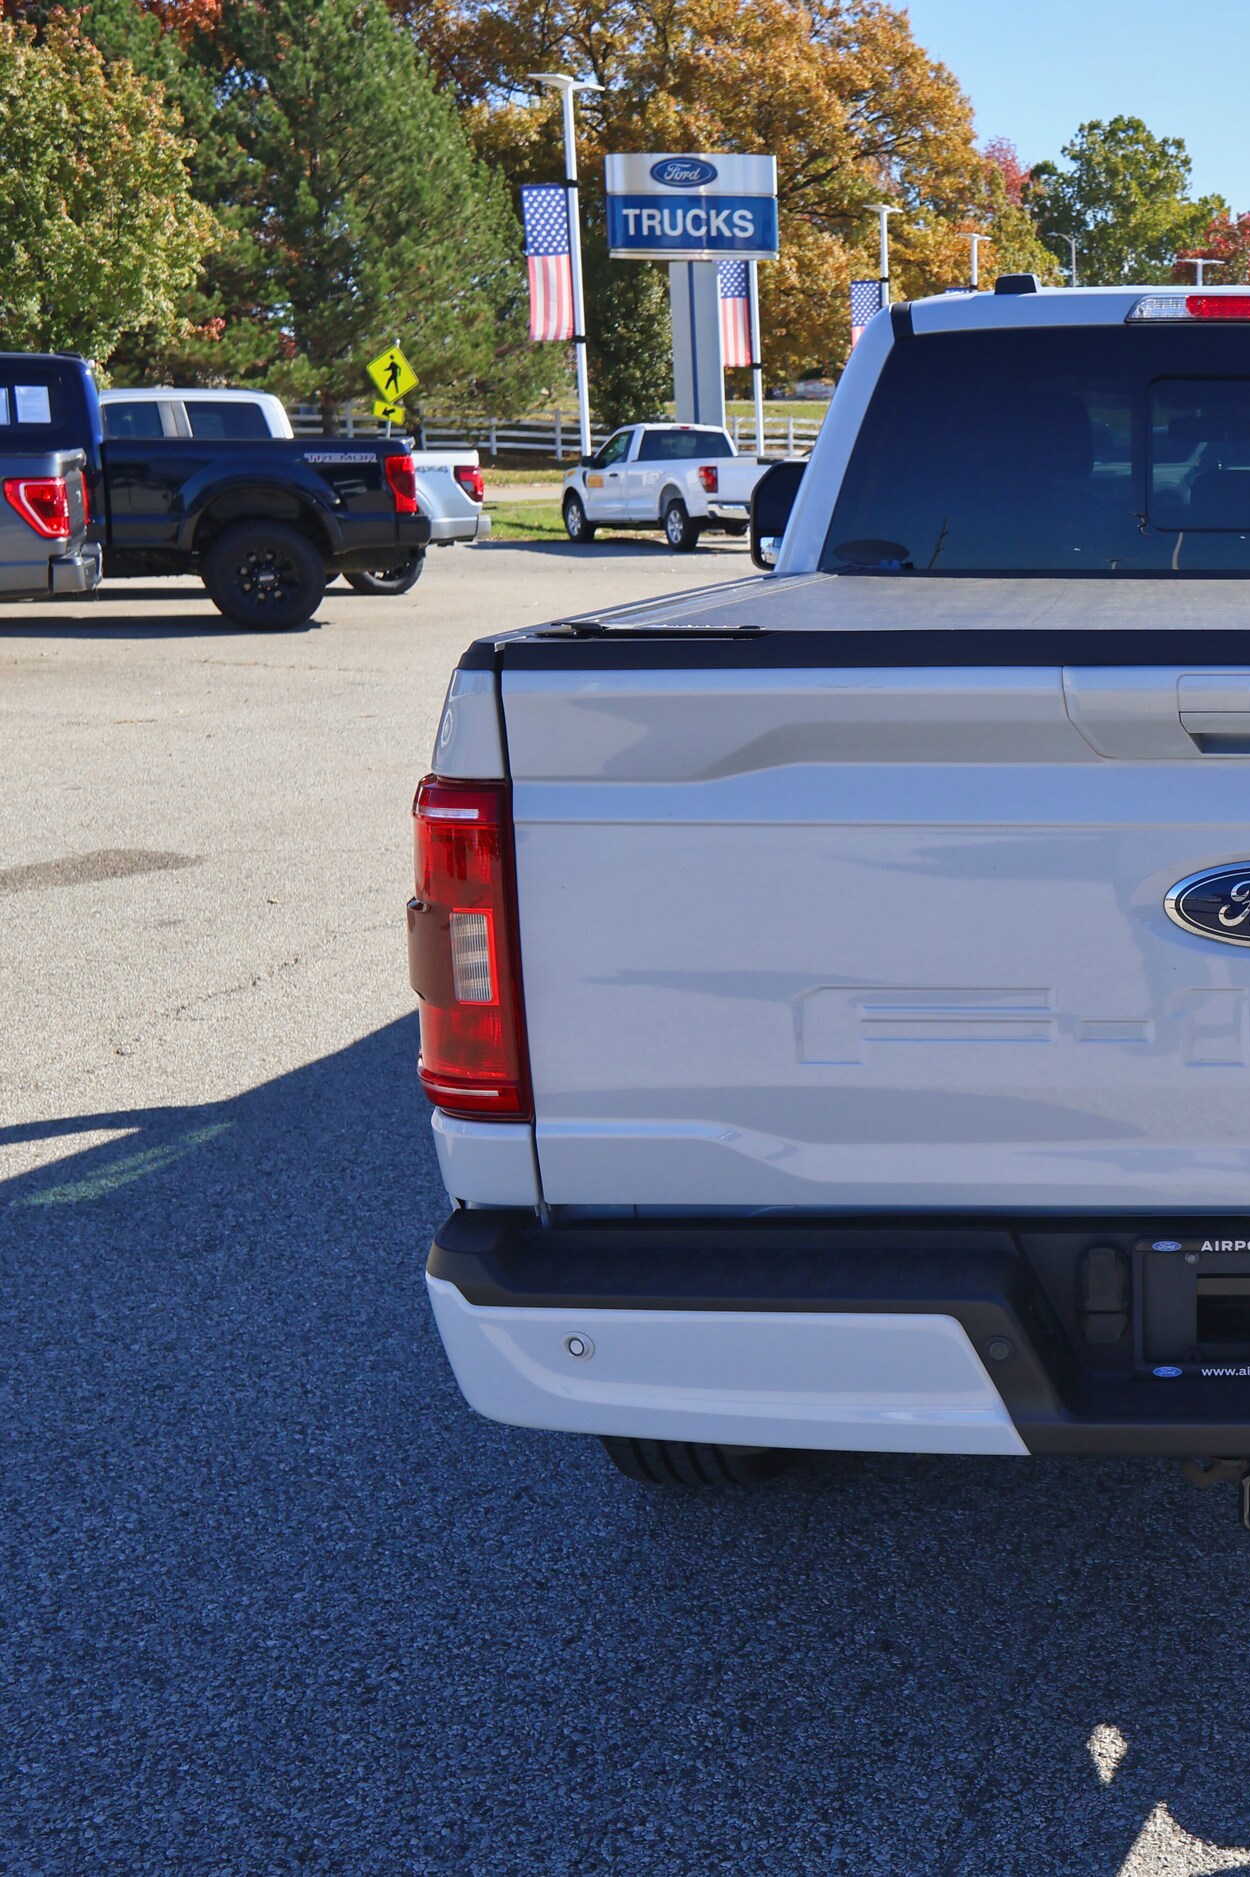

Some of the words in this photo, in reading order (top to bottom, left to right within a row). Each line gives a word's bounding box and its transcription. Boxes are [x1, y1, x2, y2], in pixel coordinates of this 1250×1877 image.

[663, 163, 701, 181] Ford
[622, 208, 755, 238] TRUCKS
[304, 452, 378, 463] TREMOR
